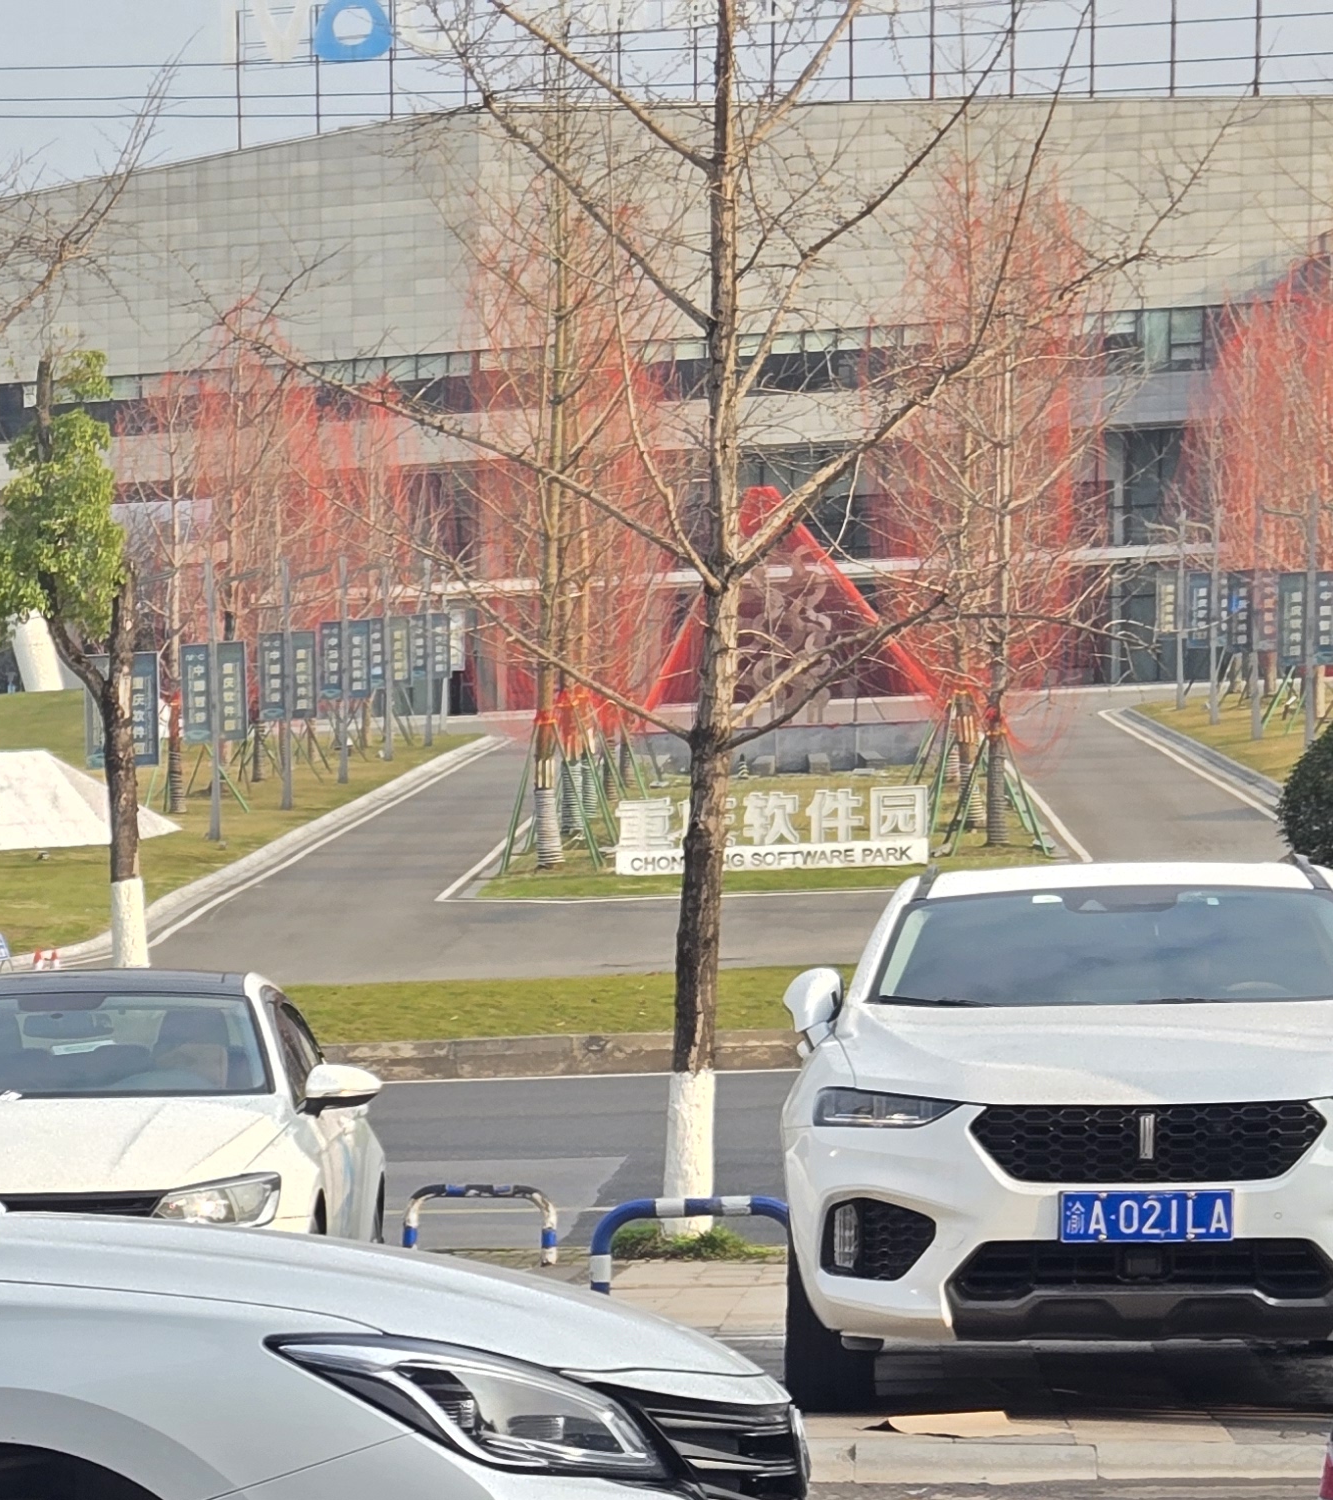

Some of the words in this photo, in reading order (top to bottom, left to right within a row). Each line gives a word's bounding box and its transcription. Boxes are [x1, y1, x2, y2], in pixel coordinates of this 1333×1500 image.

[615, 785, 928, 849] 重软件园
[750, 848, 855, 867] SOFTWARE
[861, 846, 912, 863] PARK
